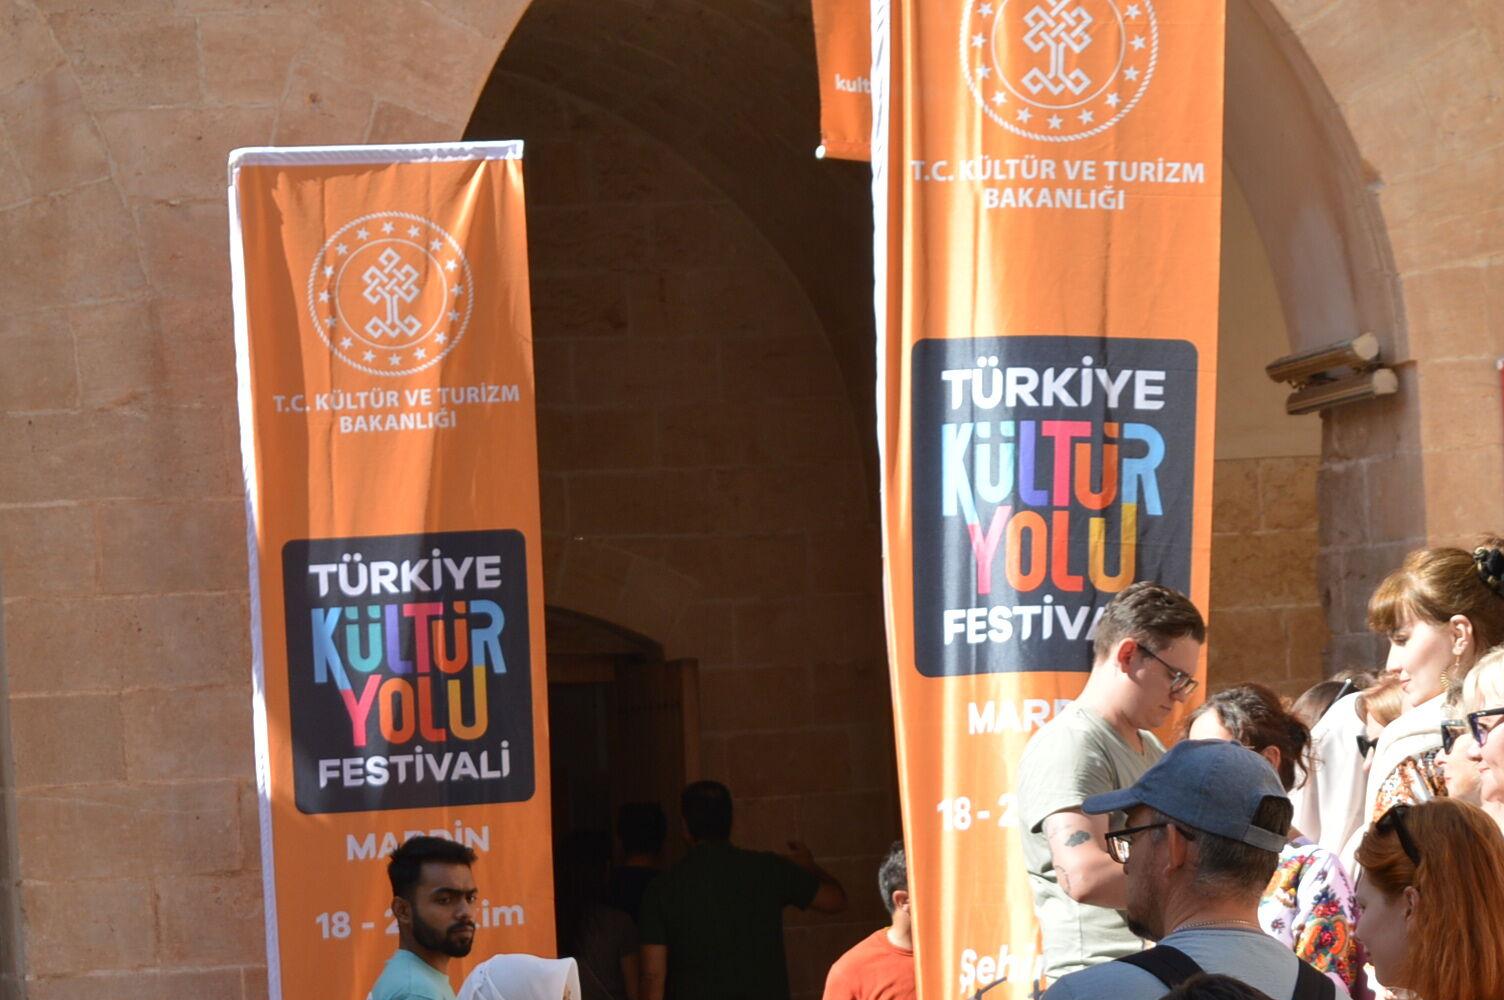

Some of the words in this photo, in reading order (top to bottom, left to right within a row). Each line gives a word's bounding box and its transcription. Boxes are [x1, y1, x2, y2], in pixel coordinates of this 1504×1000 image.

[911, 159, 955, 182] T.C.
[959, 154, 1057, 182] KÜLTÜR
[1063, 159, 1097, 181] VE
[1103, 157, 1206, 184] TURİZM
[984, 184, 1126, 211] BAKANLIĞI
[273, 392, 311, 413] T.C.
[315, 386, 400, 412] KÜLTÜR
[405, 388, 432, 407] VE
[438, 382, 521, 405] TURİZM
[941, 355, 1167, 411] TÜRKİYE
[340, 409, 457, 434] BAKANLIĞI
[941, 419, 1168, 526] KÜLTÜR
[968, 502, 1138, 596] YOLU
[308, 547, 503, 598] TÜRKİYE
[311, 599, 508, 691] KÜLTÜR
[340, 664, 489, 749] YOLU
[967, 698, 1075, 735] MAR
[318, 739, 511, 790] FESTİVALİ
[937, 795, 972, 832] 18
[316, 910, 351, 939] 18
